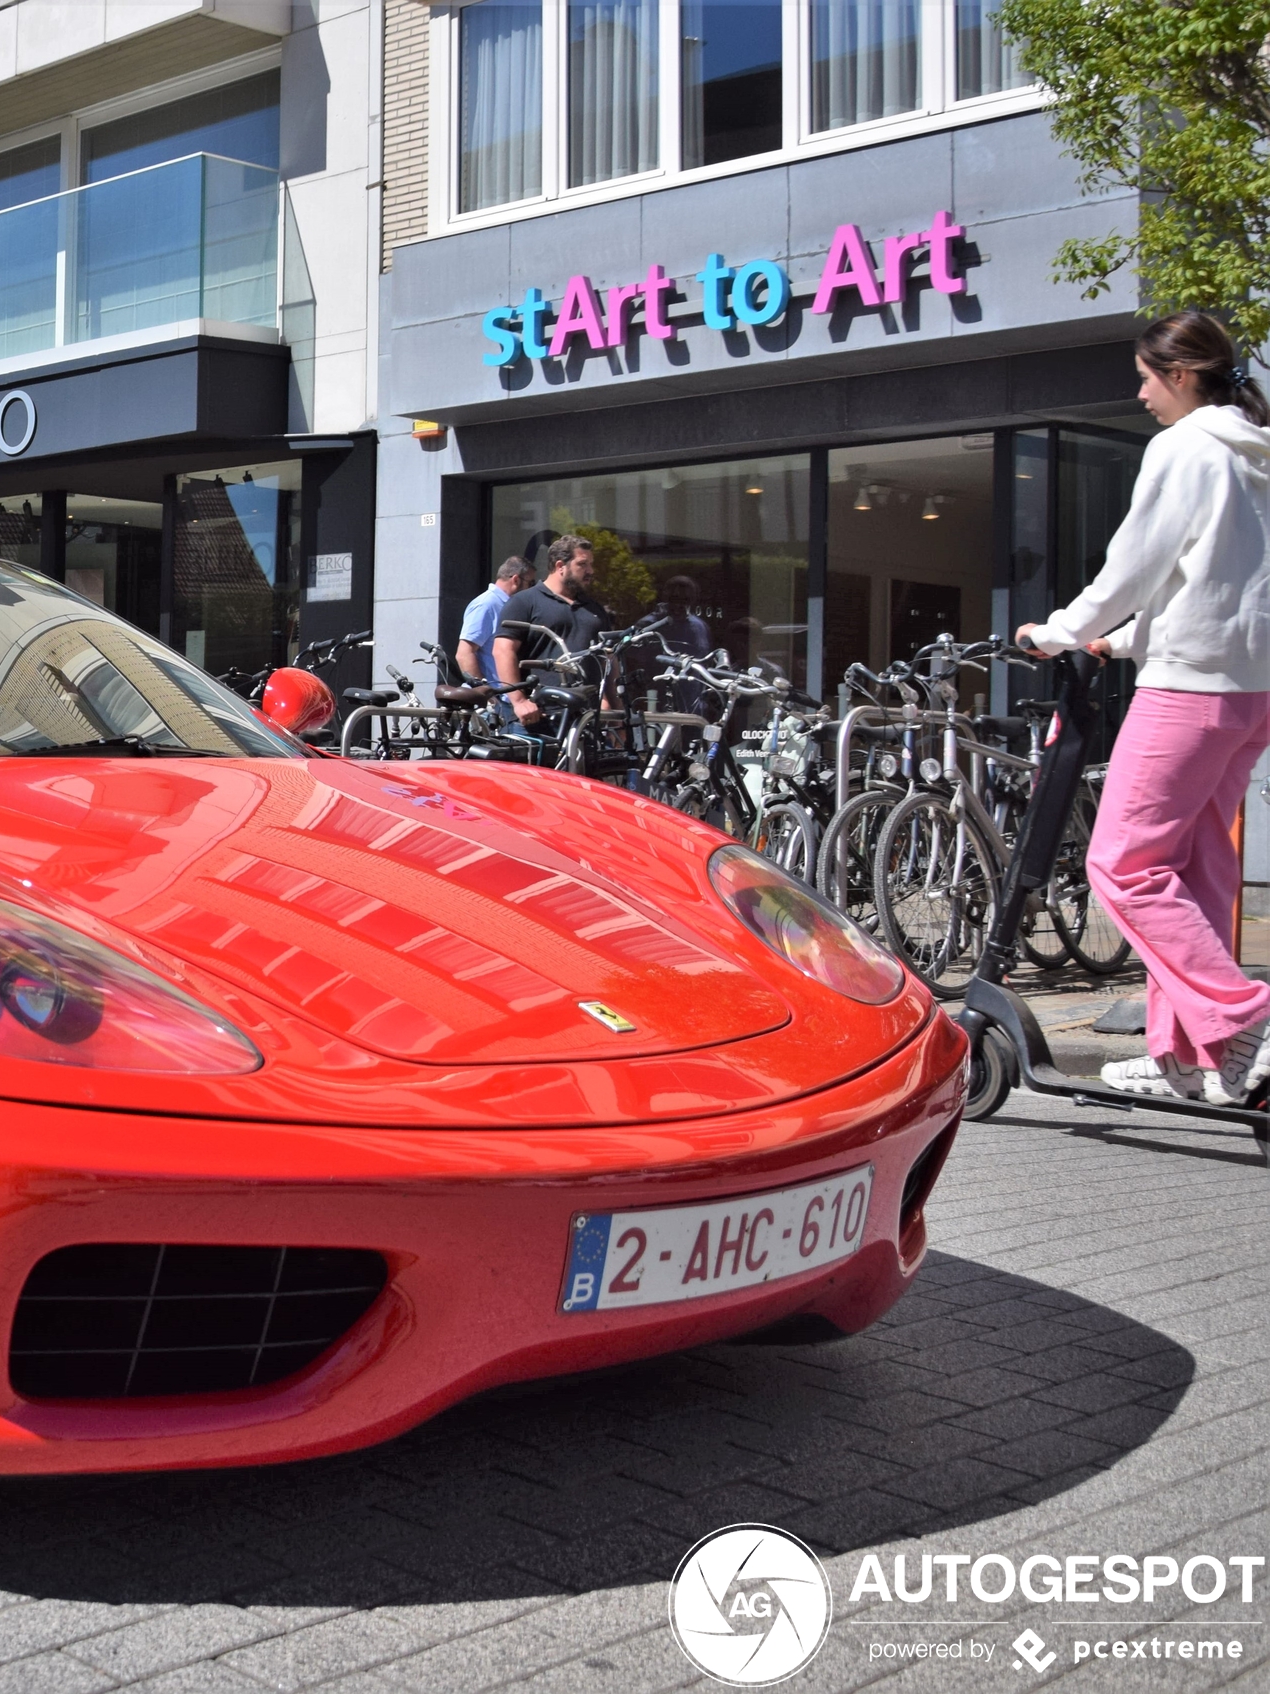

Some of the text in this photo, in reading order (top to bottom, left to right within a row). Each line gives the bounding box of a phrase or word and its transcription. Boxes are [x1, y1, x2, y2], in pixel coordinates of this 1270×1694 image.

[482, 210, 966, 367] stArt to Art
[423, 515, 433, 525] 165
[309, 555, 352, 574] BERKO
[736, 749, 754, 757] Edith
[608, 1182, 866, 1293] 2-AHC-610
[571, 1273, 594, 1302] B
